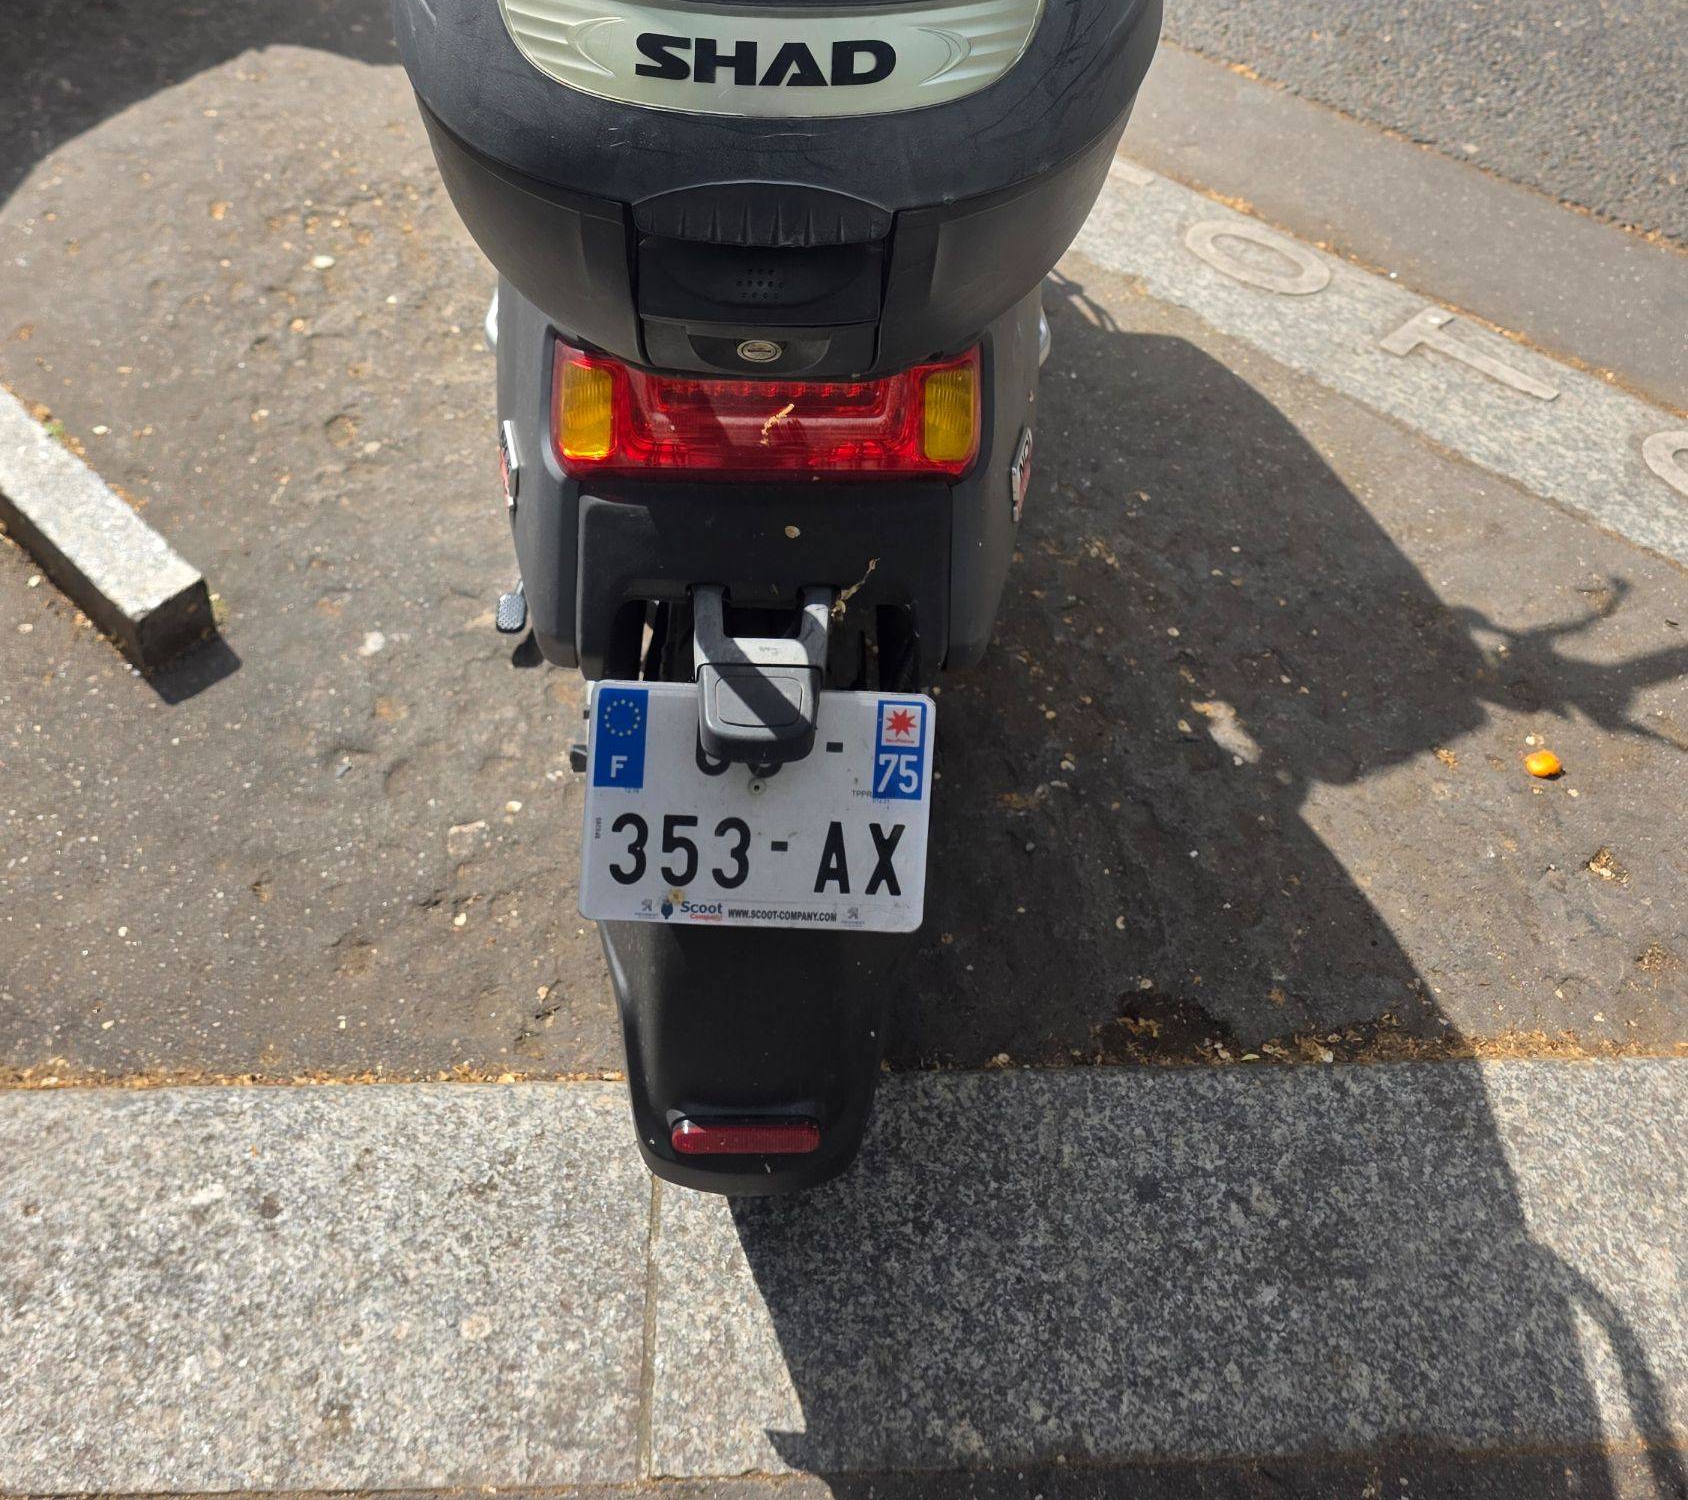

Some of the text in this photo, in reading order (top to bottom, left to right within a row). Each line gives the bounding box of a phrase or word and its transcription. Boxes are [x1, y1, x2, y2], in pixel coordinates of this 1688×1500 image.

[635, 33, 896, 86] SHAD
[610, 755, 628, 778] F
[877, 753, 919, 794] 75
[680, 900, 723, 915] Scoot
[727, 908, 838, 923] WWW.SCOOT-COMPANY.COM
